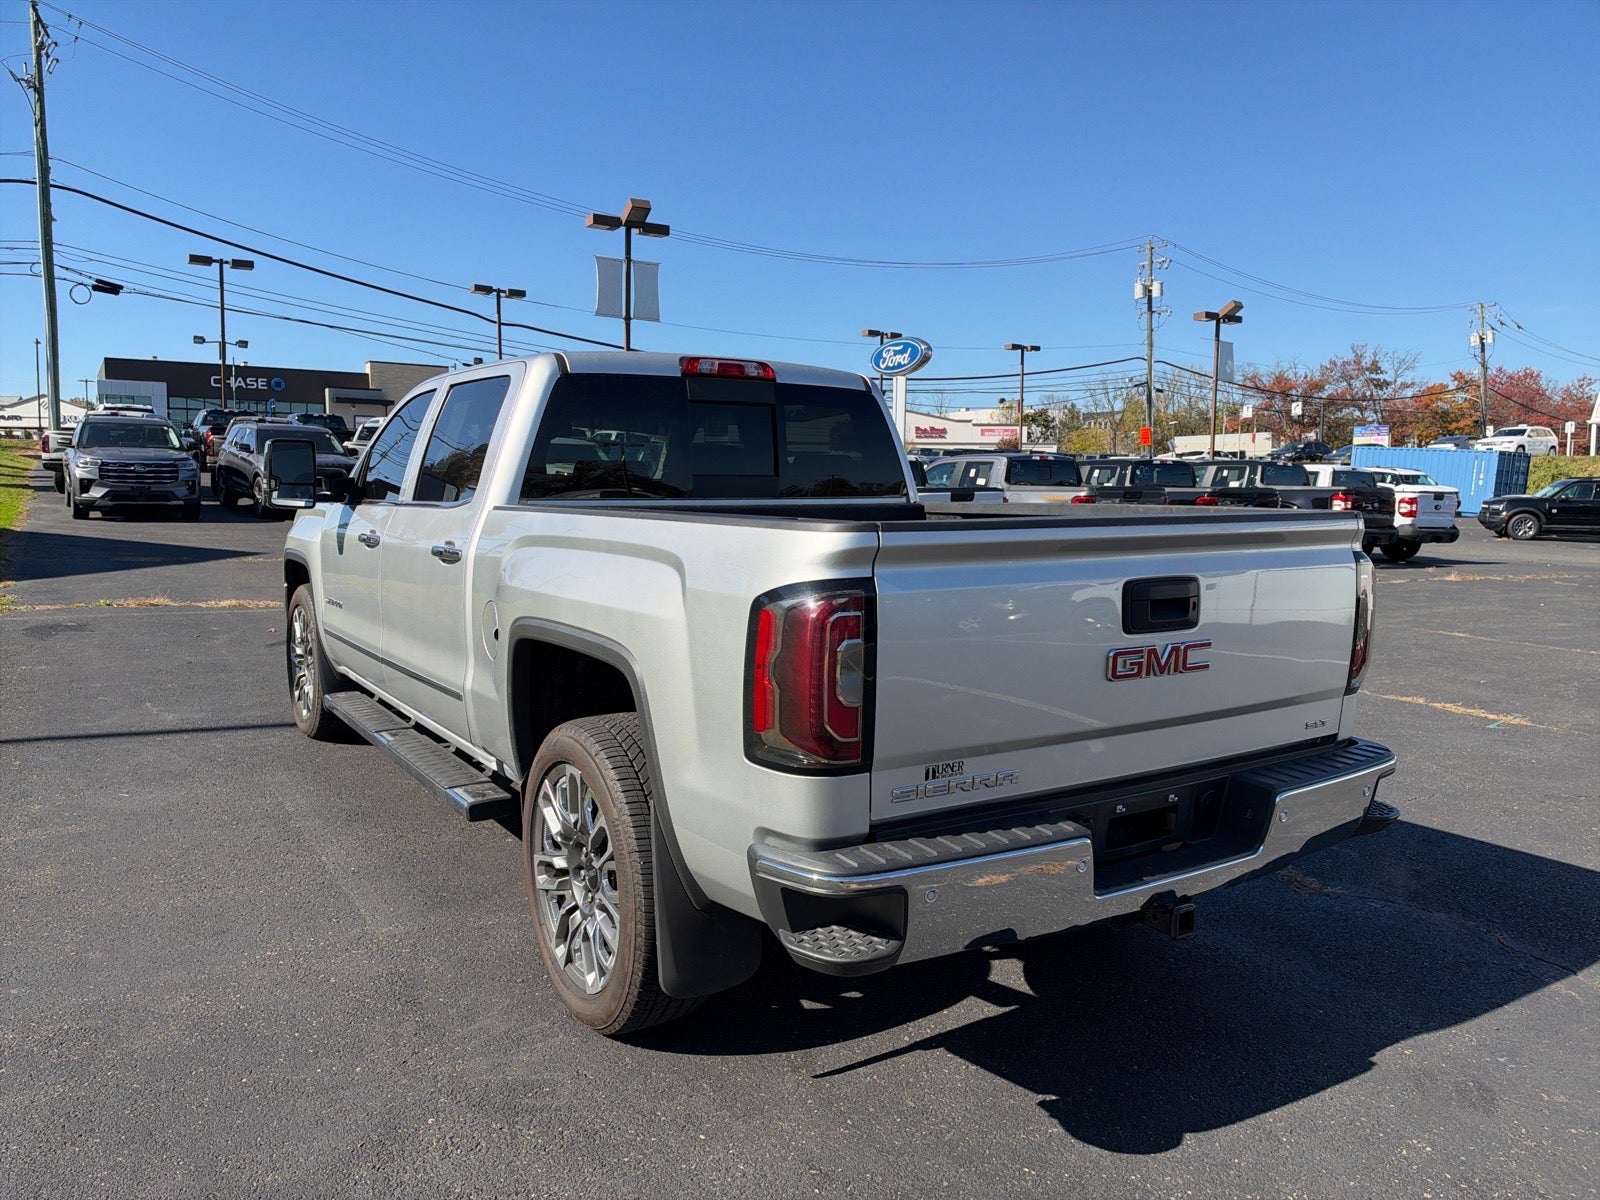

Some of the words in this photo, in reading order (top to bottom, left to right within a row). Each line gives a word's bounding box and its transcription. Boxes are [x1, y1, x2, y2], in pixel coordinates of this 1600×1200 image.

[880, 345, 912, 369] Ford
[210, 375, 268, 390] CHASE
[1106, 639, 1213, 681] GMC
[925, 760, 964, 780] TURNER
[891, 769, 1020, 803] SIERRA
